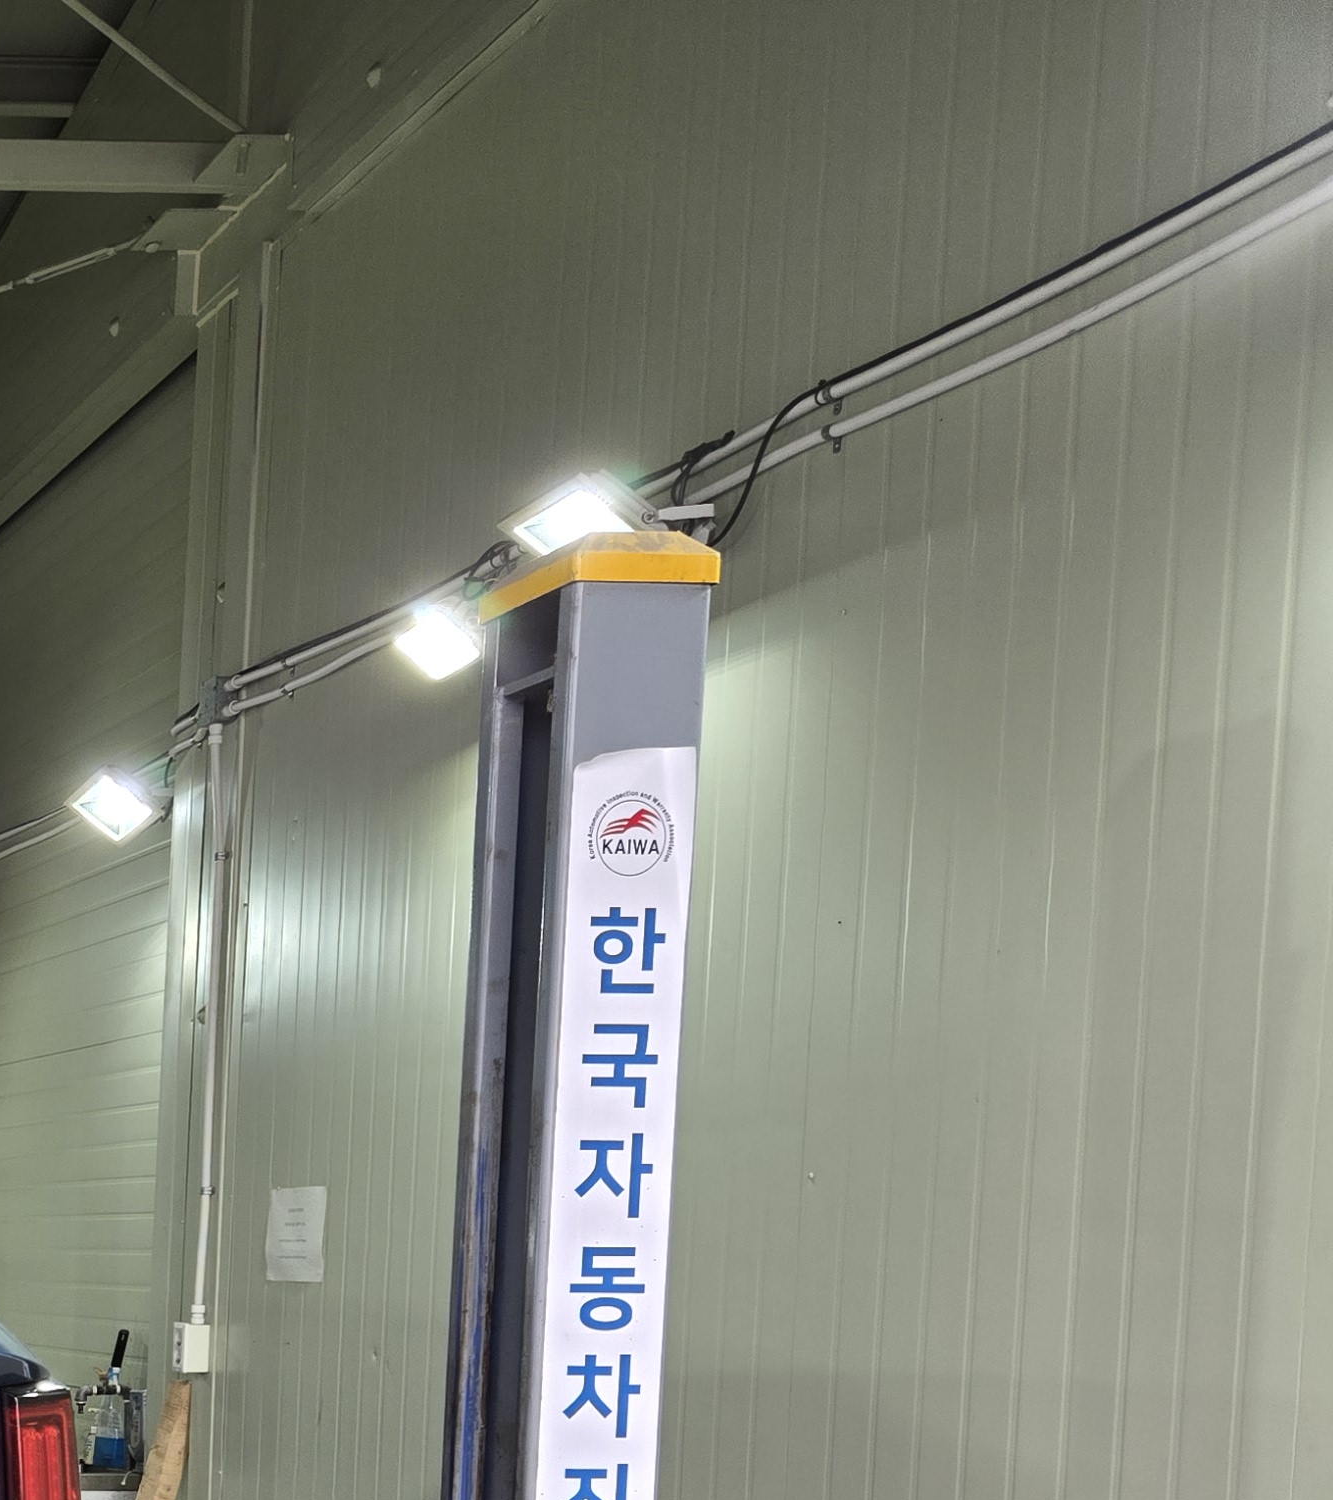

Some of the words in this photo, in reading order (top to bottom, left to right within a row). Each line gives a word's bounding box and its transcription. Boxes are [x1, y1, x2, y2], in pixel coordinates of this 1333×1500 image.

[606, 790, 639, 804] Inspection
[640, 792, 652, 800] and
[602, 838, 660, 855] KAIWA
